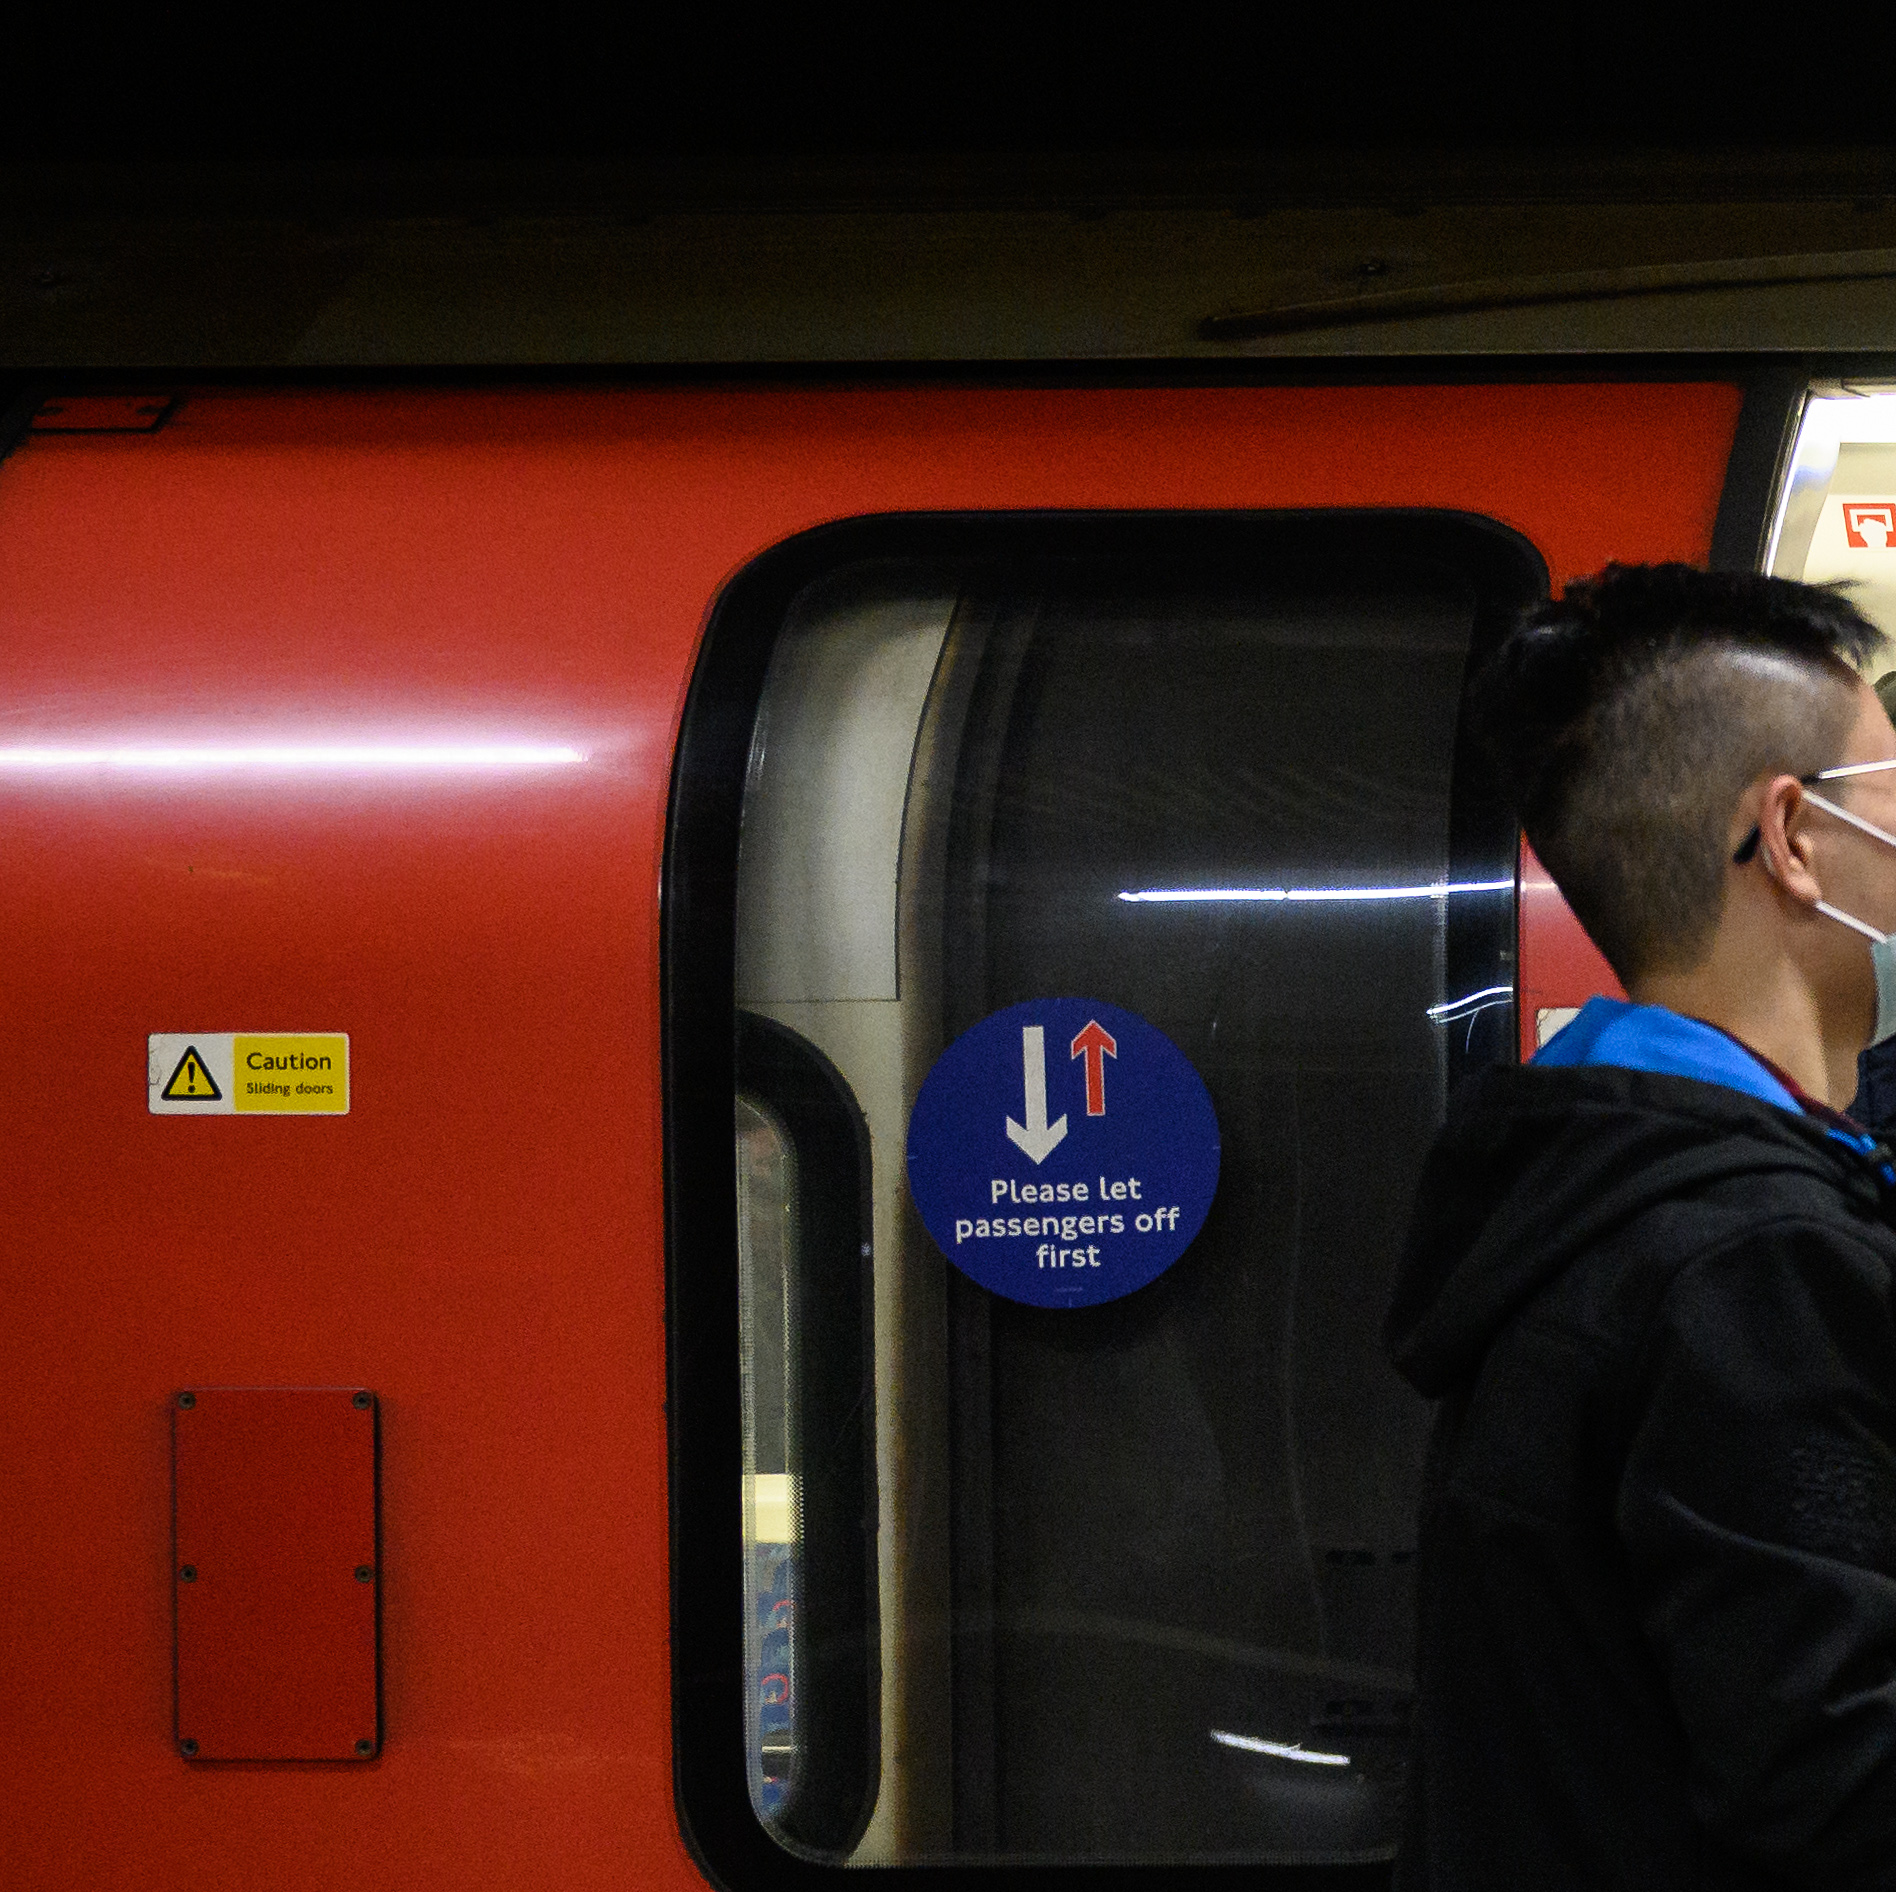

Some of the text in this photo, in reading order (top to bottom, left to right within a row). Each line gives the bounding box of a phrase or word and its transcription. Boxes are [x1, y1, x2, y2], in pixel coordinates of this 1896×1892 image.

[246, 1051, 332, 1071] Caution
[246, 1082, 333, 1097] Sliding doors
[990, 1175, 1142, 1204] Please let
[955, 1206, 1181, 1245] passengers off
[1036, 1243, 1102, 1269] first
